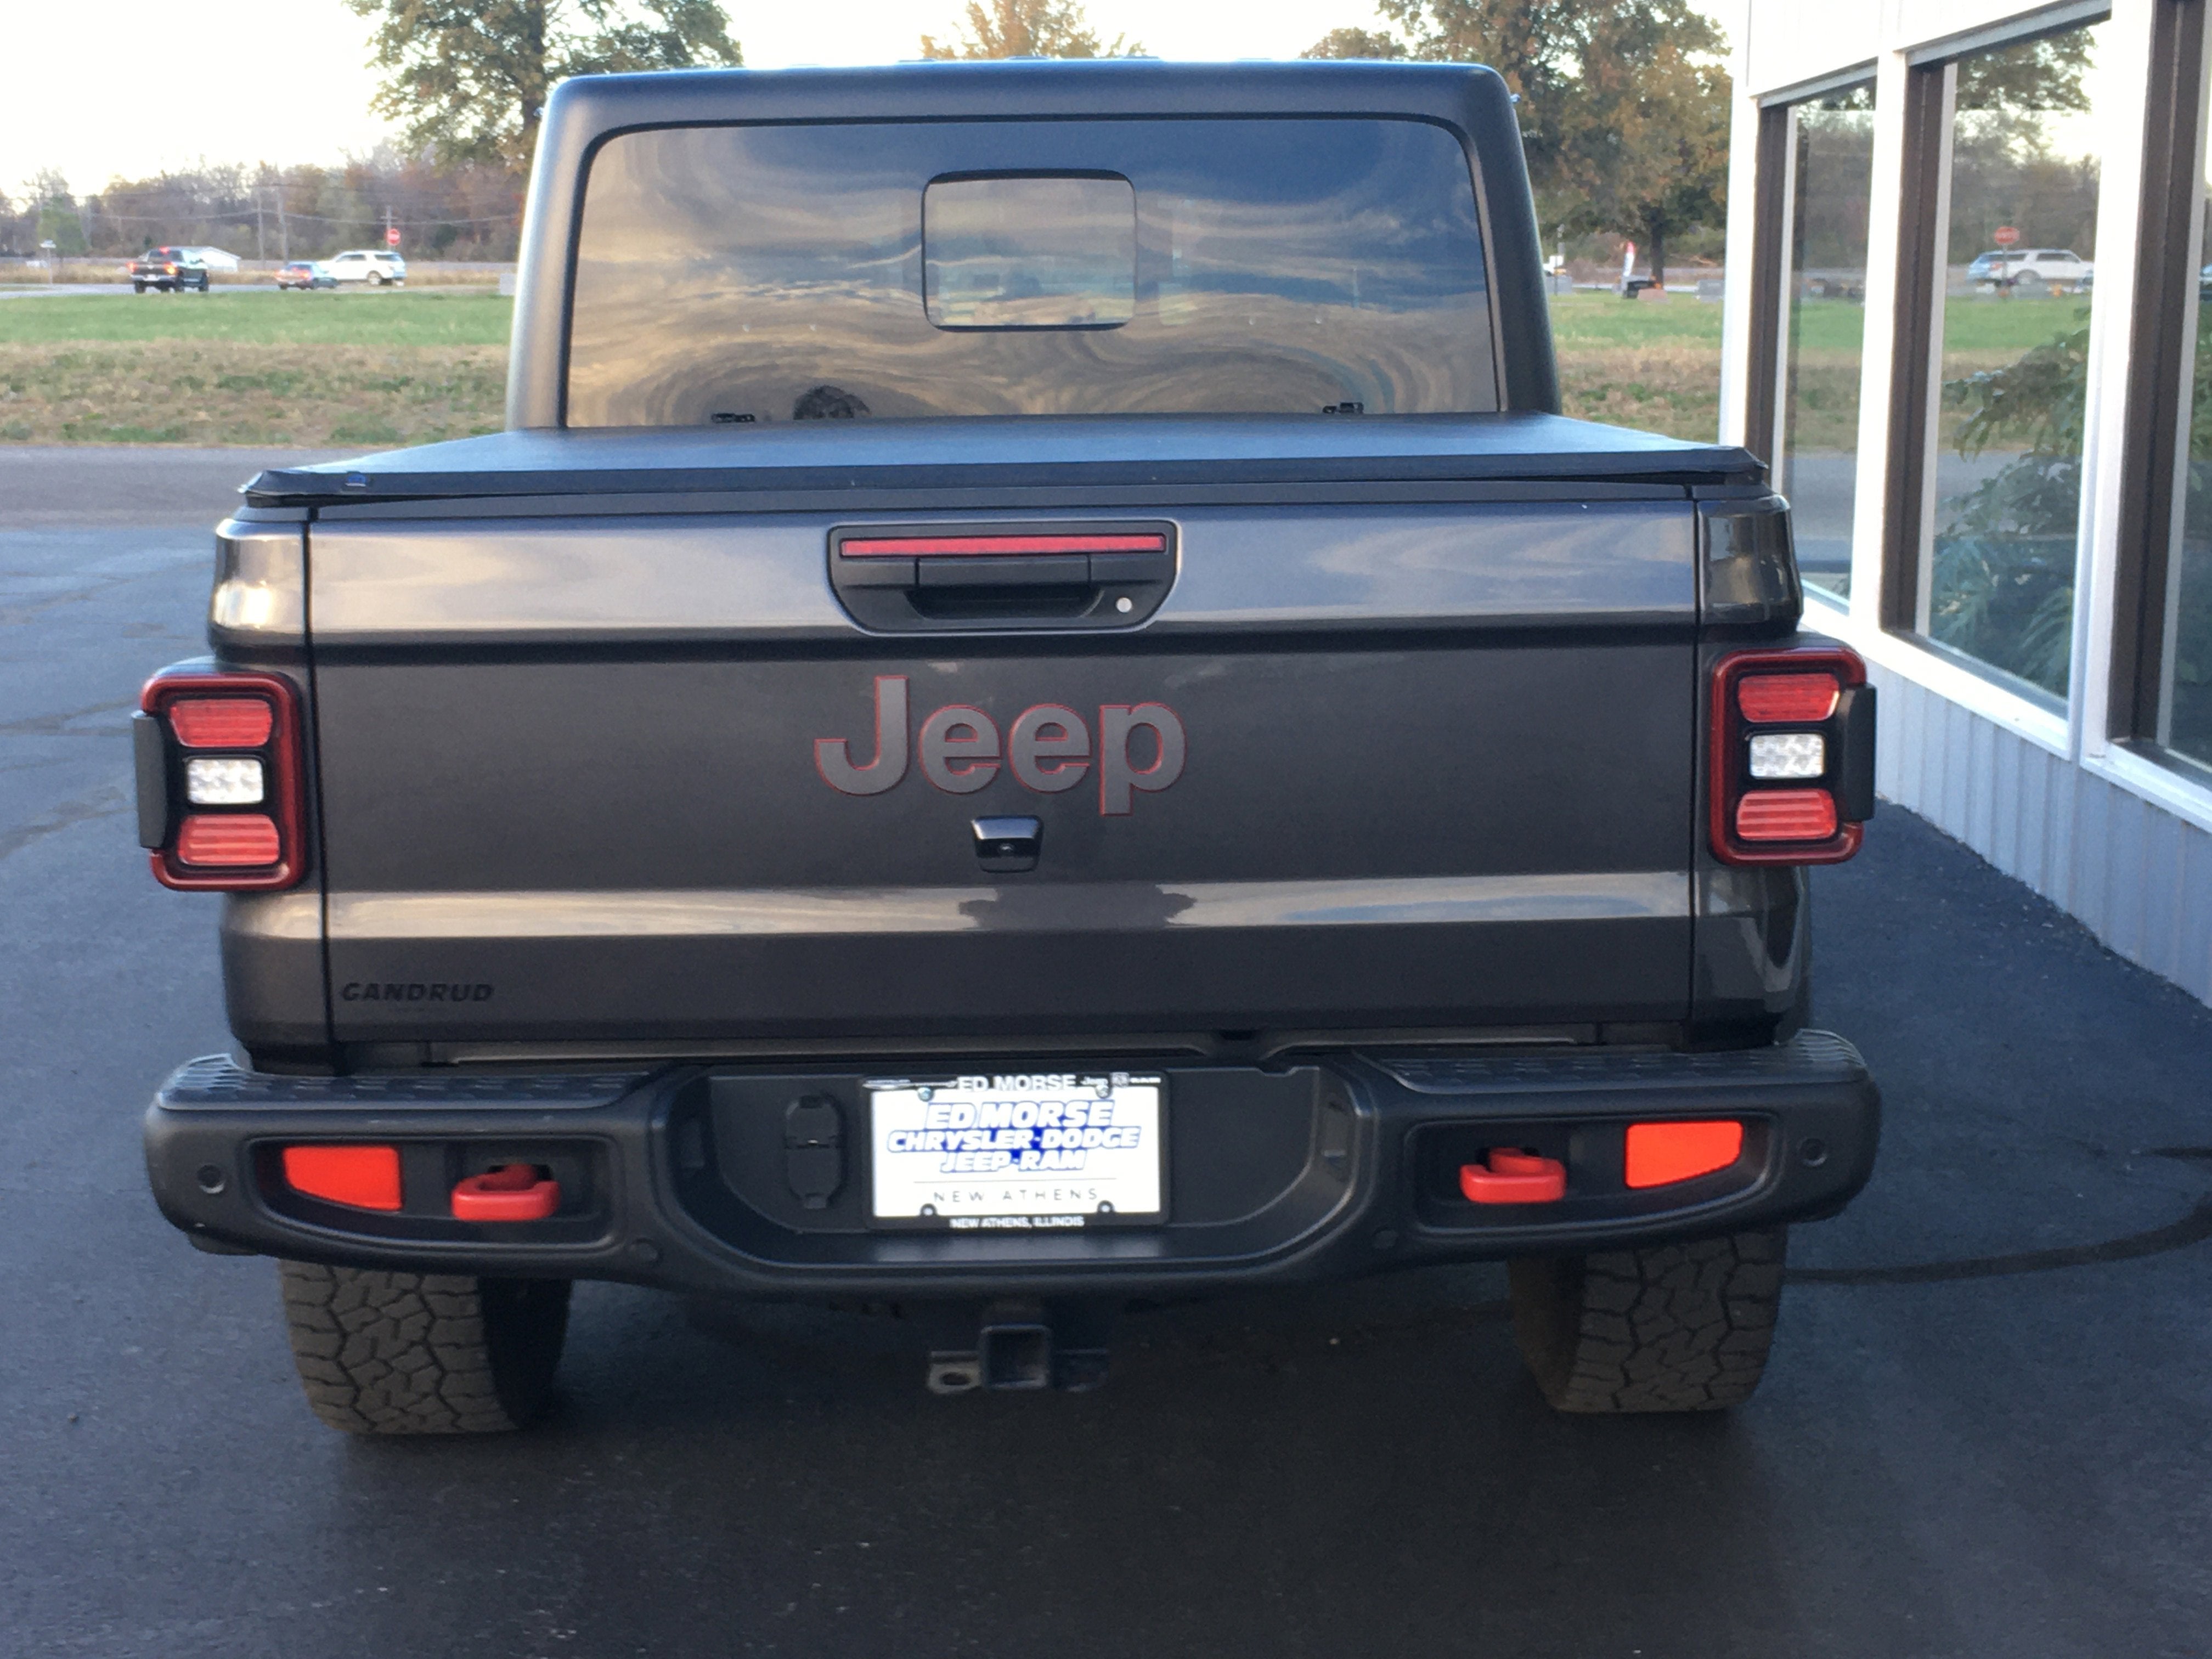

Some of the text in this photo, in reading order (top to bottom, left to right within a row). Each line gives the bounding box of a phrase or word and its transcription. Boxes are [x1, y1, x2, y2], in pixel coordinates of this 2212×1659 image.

[814, 675, 1187, 816] Jeep
[957, 1074, 1076, 1092] ED MORSE
[926, 1100, 1114, 1128] ED MORSE
[934, 1188, 1097, 1202] NEW ATHENS
[949, 1217, 979, 1228] NEW
[1032, 1215, 1085, 1227] ILLINOIS
